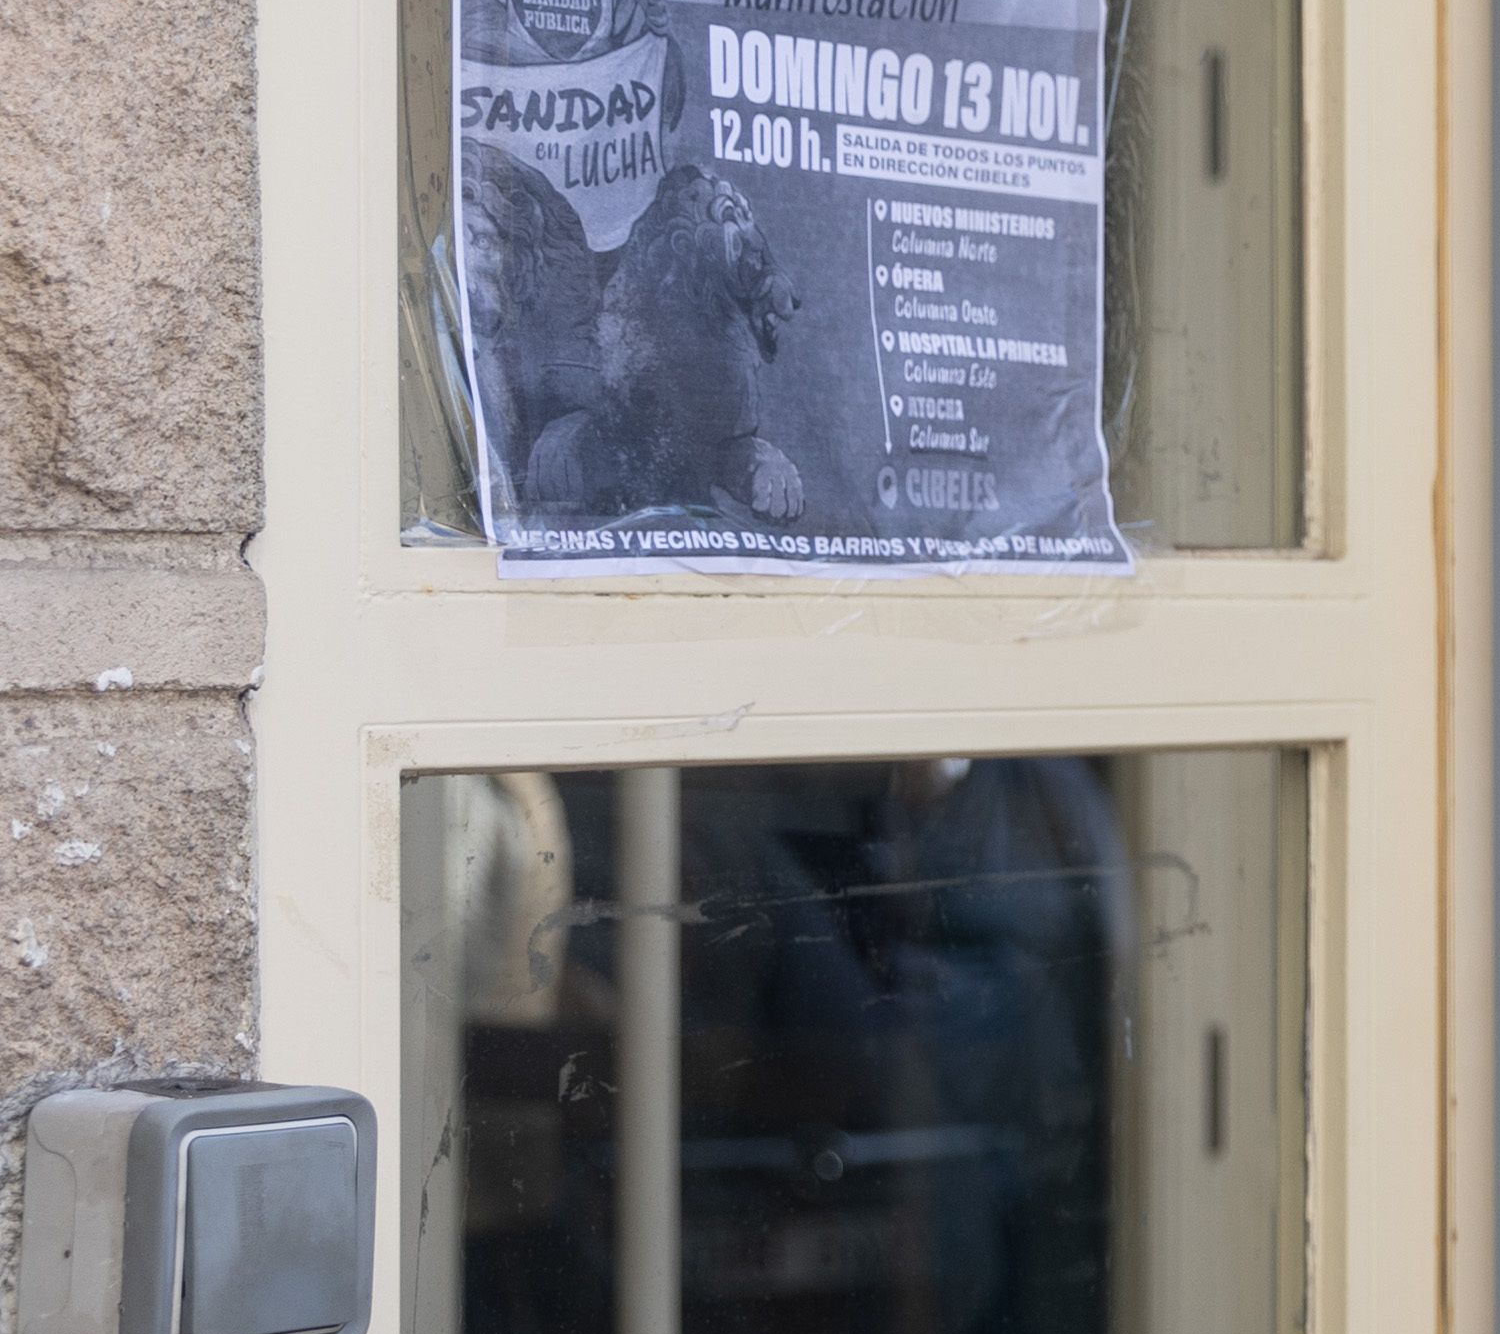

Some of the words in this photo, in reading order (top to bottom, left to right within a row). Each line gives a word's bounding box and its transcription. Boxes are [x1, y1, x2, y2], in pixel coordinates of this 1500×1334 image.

[524, 6, 591, 35] PÚBLICA
[709, 24, 933, 125] DOMINGO
[943, 58, 992, 133] 13
[1002, 67, 1089, 146] NOV.
[461, 80, 655, 132] SANIDAD
[710, 108, 793, 167] 12.00
[800, 117, 831, 173] h.
[843, 133, 901, 152] SALIDA
[908, 141, 928, 156] DE
[933, 144, 989, 163] TODOS
[994, 152, 1023, 167] LOS
[1028, 155, 1087, 175] PUNTOS
[536, 142, 559, 160] en
[565, 131, 657, 189] LUCHA
[843, 153, 864, 168] EN
[869, 156, 958, 182] DIRECCIÓN
[963, 169, 1030, 188] CIBELES
[891, 201, 953, 228] NUEVOS
[955, 208, 1055, 240] MINISTERIOS
[892, 230, 954, 258] Columna
[958, 235, 998, 263] Norte
[892, 262, 944, 293] ÓPERA
[895, 295, 958, 322] Columna
[962, 299, 998, 327] Oeste
[898, 331, 976, 358] HOSPITAL
[976, 338, 997, 360] LA
[998, 339, 1067, 367] PRINCESA
[904, 359, 965, 386] Columna
[969, 363, 997, 390] Este
[909, 424, 966, 451] Columna
[969, 427, 990, 453] Sur
[905, 467, 999, 511] CIBELES
[510, 529, 615, 552] VECINAS
[618, 531, 634, 550] Y
[638, 530, 739, 550] VECINOS
[740, 531, 771, 550] DE
[769, 535, 811, 555] LOS
[814, 535, 905, 557] BARRIOS
[906, 537, 923, 556] Y
[923, 535, 1010, 558] PUEBLOS
[1011, 535, 1037, 555] DE
[1039, 536, 1114, 556] MADRID
